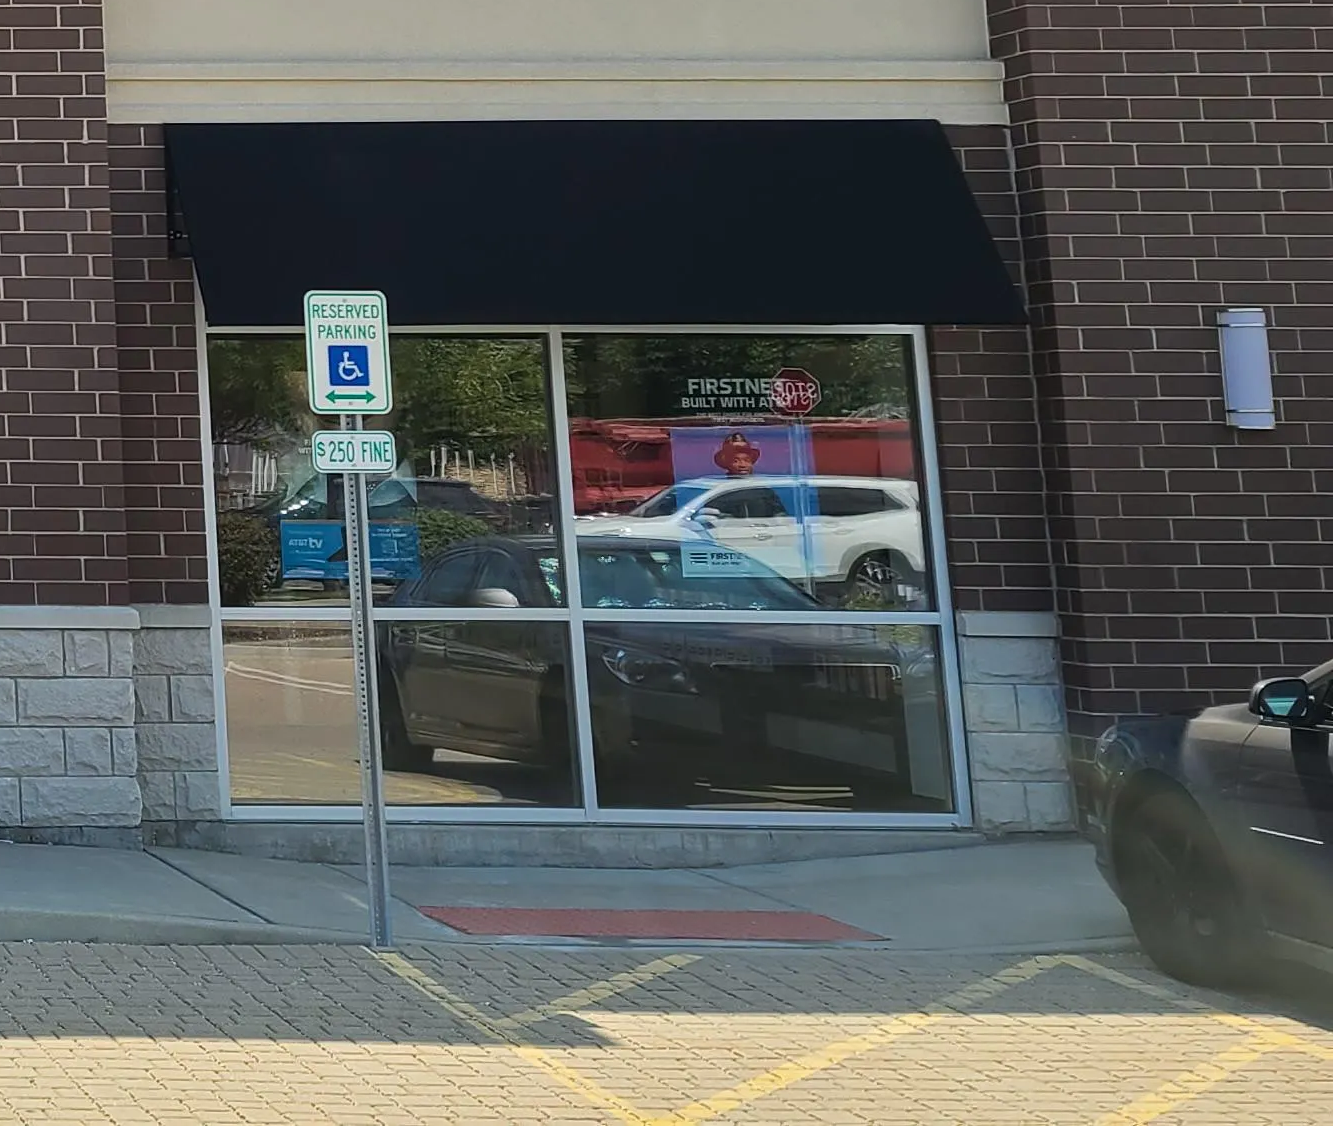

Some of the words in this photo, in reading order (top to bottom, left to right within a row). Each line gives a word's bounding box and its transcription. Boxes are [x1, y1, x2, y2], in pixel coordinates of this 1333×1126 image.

[312, 304, 380, 319] RESERVED
[318, 324, 376, 340] PARKING
[682, 397, 717, 409] BUILT
[721, 397, 756, 409] WITH
[329, 441, 355, 463] 250
[361, 441, 392, 463] FINE
